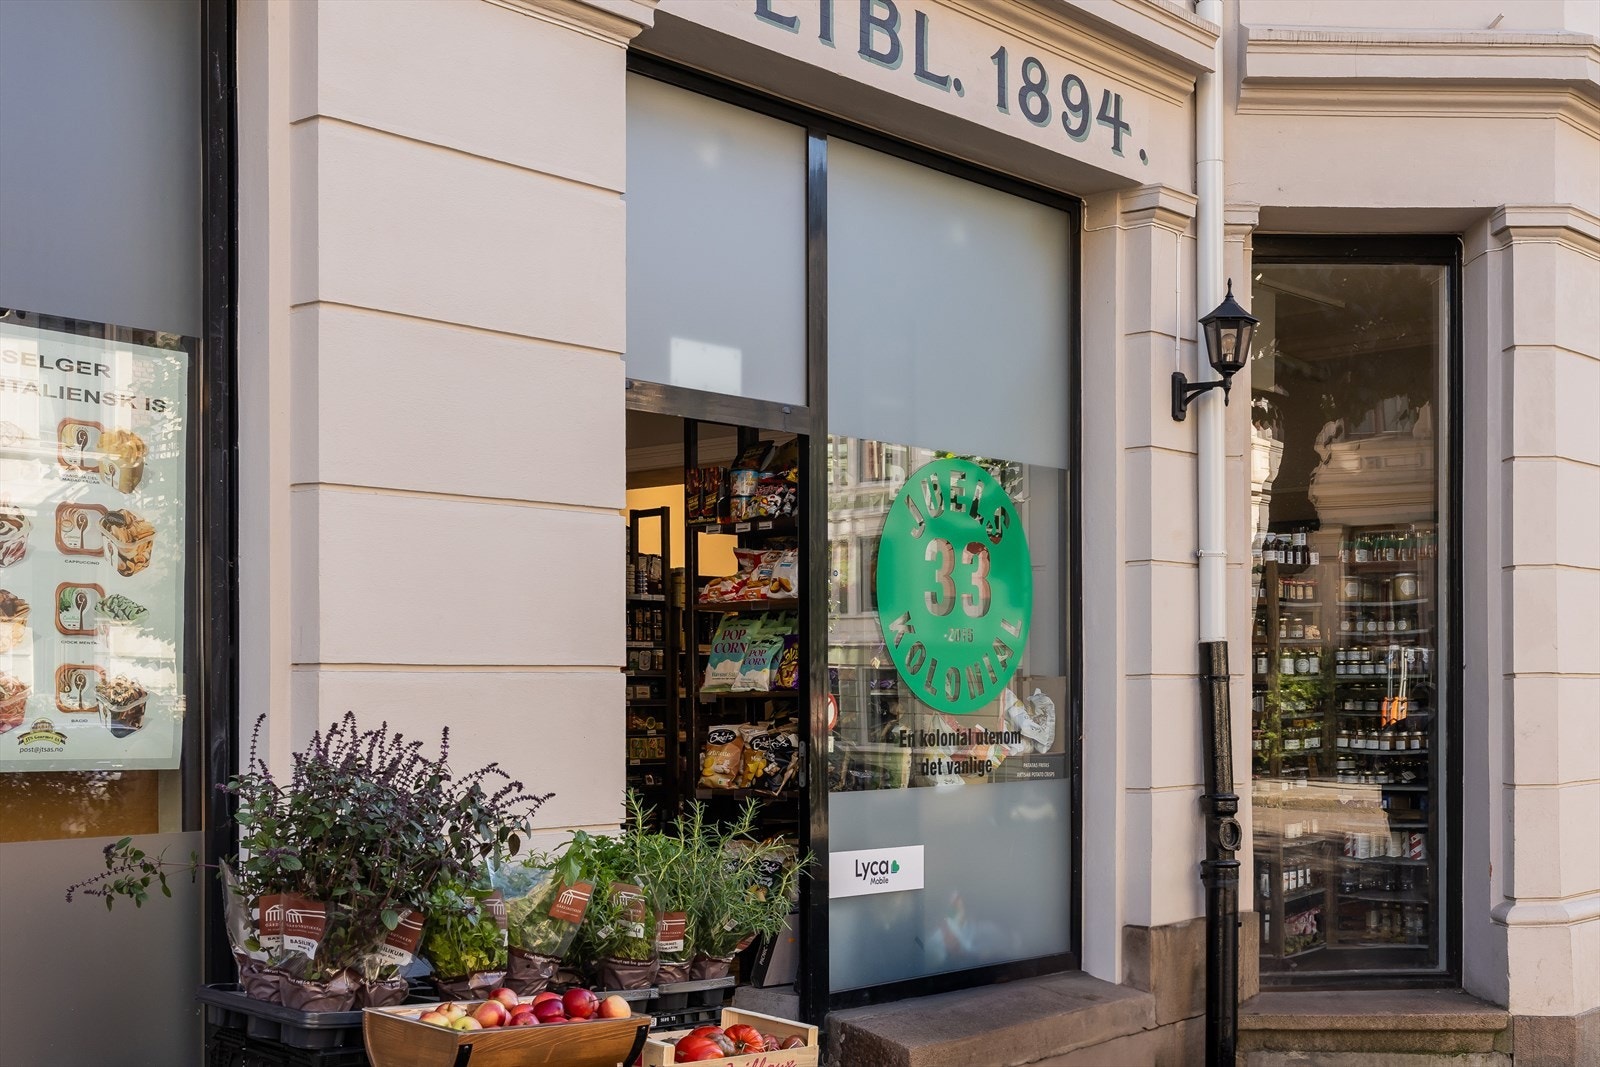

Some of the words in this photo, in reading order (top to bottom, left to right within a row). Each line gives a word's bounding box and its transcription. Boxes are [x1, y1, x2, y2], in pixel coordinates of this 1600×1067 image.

[990, 45, 1149, 166] 1894.
[2, 350, 111, 379] SELGER
[145, 397, 167, 413] IS
[905, 470, 1010, 545] JUELS
[924, 537, 992, 618] 33
[721, 628, 747, 641] POP
[714, 642, 748, 654] CORN
[748, 649, 767, 657] POP
[889, 610, 1022, 703] KOLONIAL
[899, 730, 915, 748] En
[920, 728, 972, 747] kolonial
[975, 728, 1021, 746] utenom
[921, 758, 943, 776] det
[946, 756, 993, 777] vanlige
[855, 859, 889, 880] Lyca
[870, 877, 889, 885] Mobile
